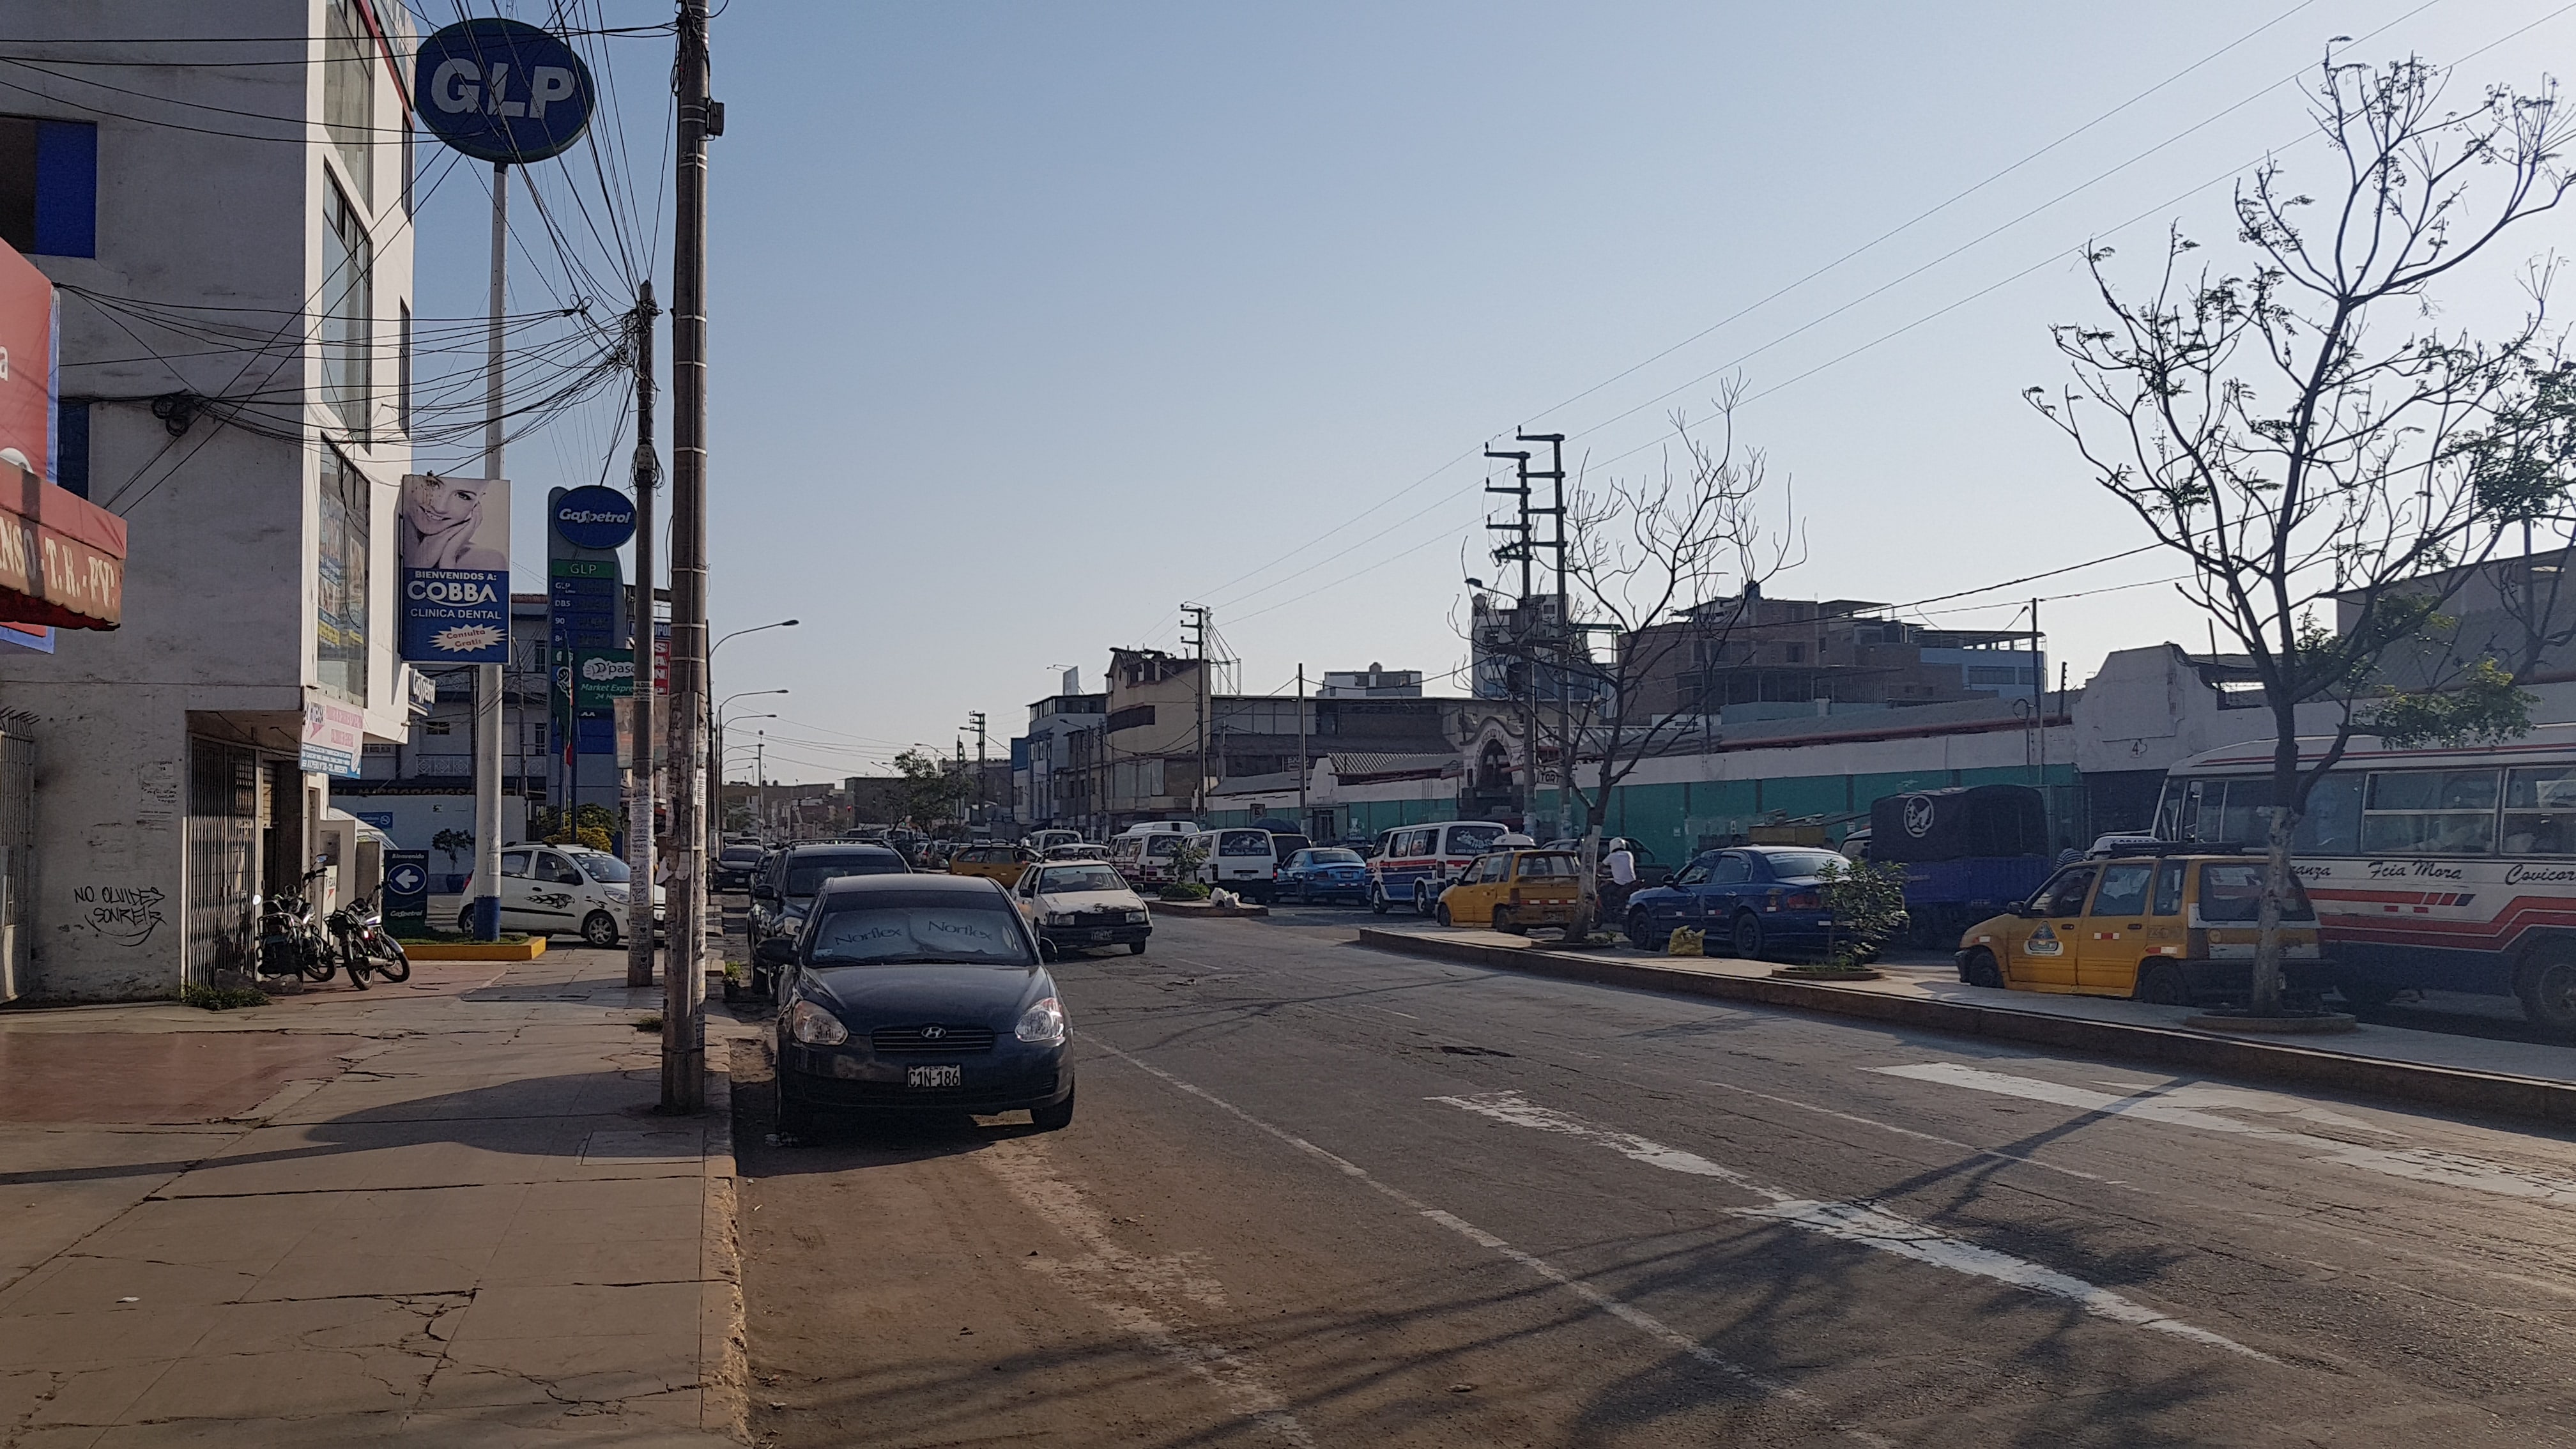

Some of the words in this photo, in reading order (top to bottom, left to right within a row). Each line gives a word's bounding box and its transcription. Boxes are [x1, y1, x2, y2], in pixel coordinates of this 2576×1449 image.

[431, 57, 575, 119] GLP
[415, 571, 484, 580] BIENVENIDOS
[570, 563, 597, 574] GLP
[407, 580, 498, 606] COBBA
[410, 608, 456, 618] CLINICA
[458, 610, 502, 620] DENTAL
[447, 629, 486, 639] Consulta
[454, 639, 482, 647] Gratis
[2412, 859, 2463, 880] Mora
[73, 885, 95, 903] NO
[834, 927, 903, 945] Norflex
[928, 920, 993, 940] Norflex
[909, 1070, 959, 1086] C1N-186
